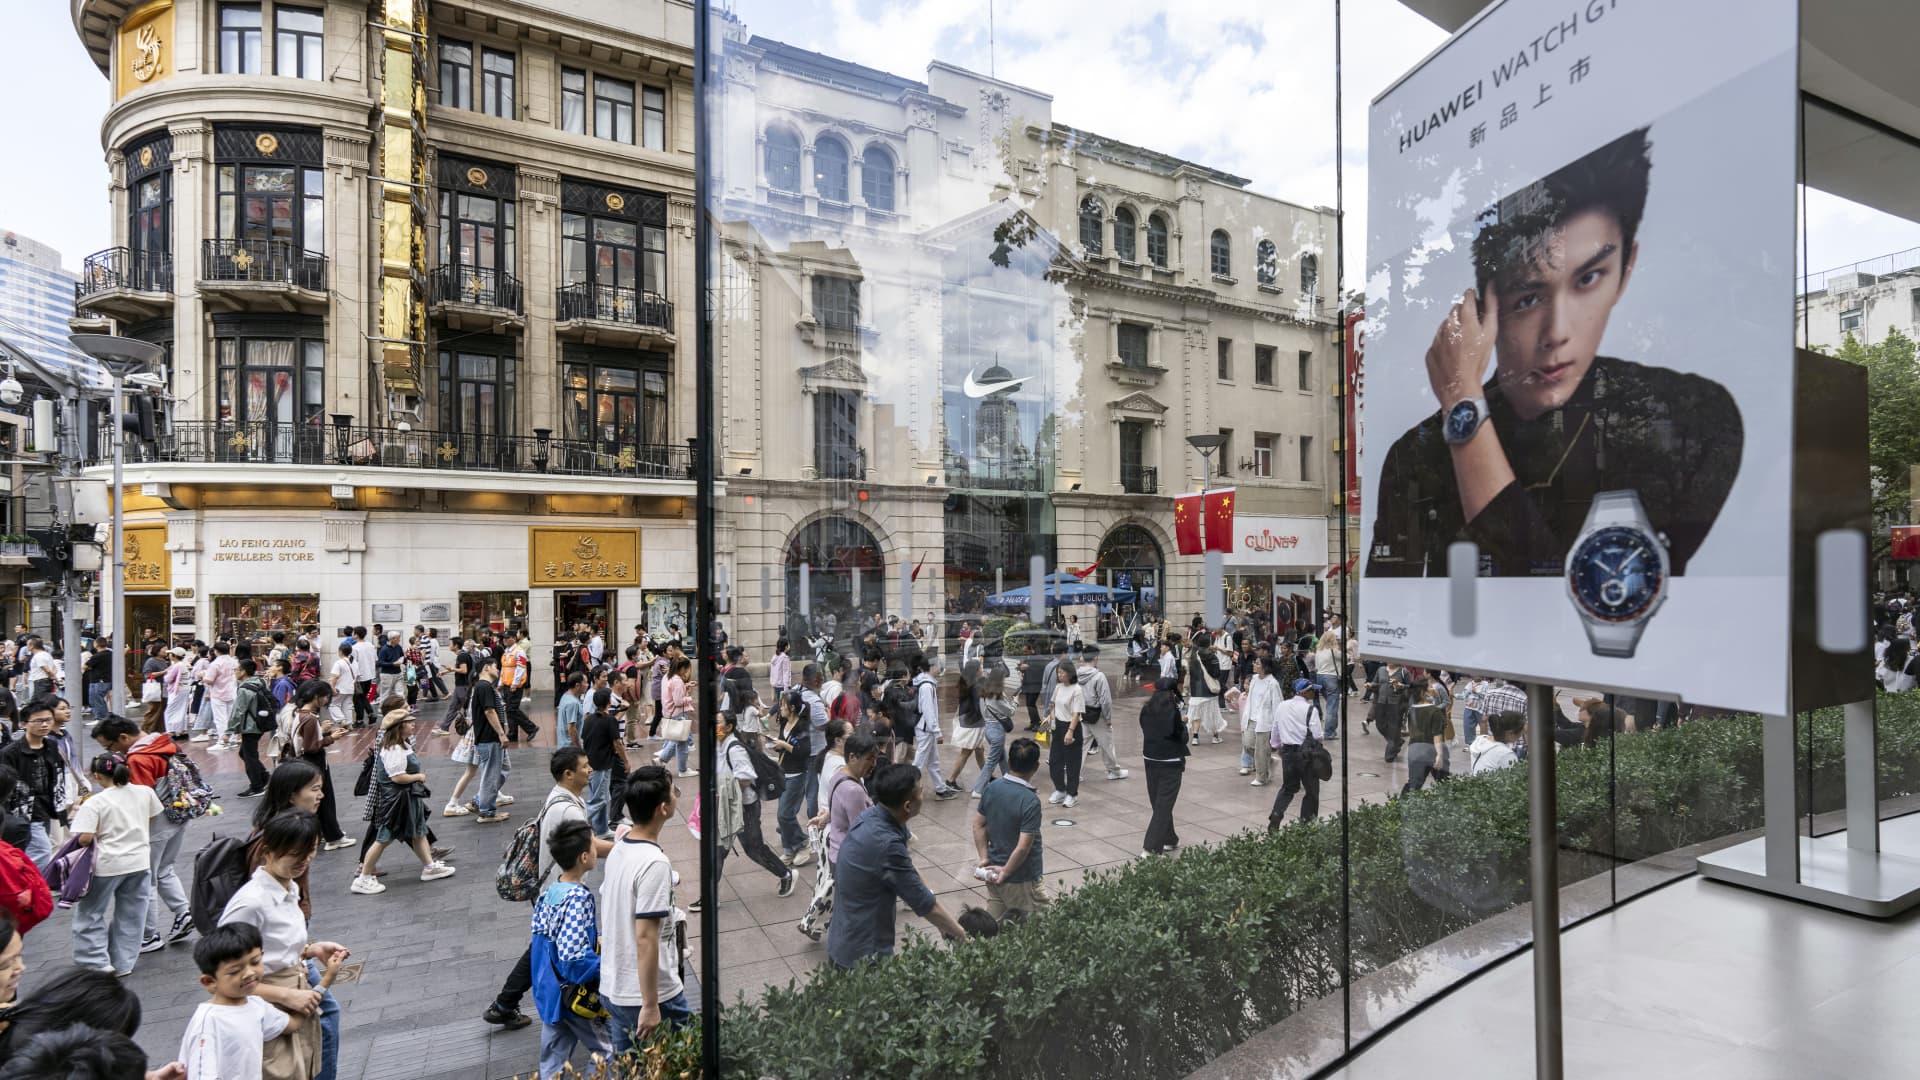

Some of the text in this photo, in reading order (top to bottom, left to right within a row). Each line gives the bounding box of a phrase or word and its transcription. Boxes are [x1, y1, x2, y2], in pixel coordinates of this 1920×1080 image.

[1399, 79, 1483, 154] HUAWEI
[1492, 12, 1578, 88] WATCH
[1469, 55, 1591, 149] 新品上市
[219, 539, 306, 548] LAO FENG XIANG
[213, 552, 314, 561] JEWELLERS STORE
[1082, 594, 1107, 602] POLICE
[1368, 625, 1408, 639] HarmonyOS
